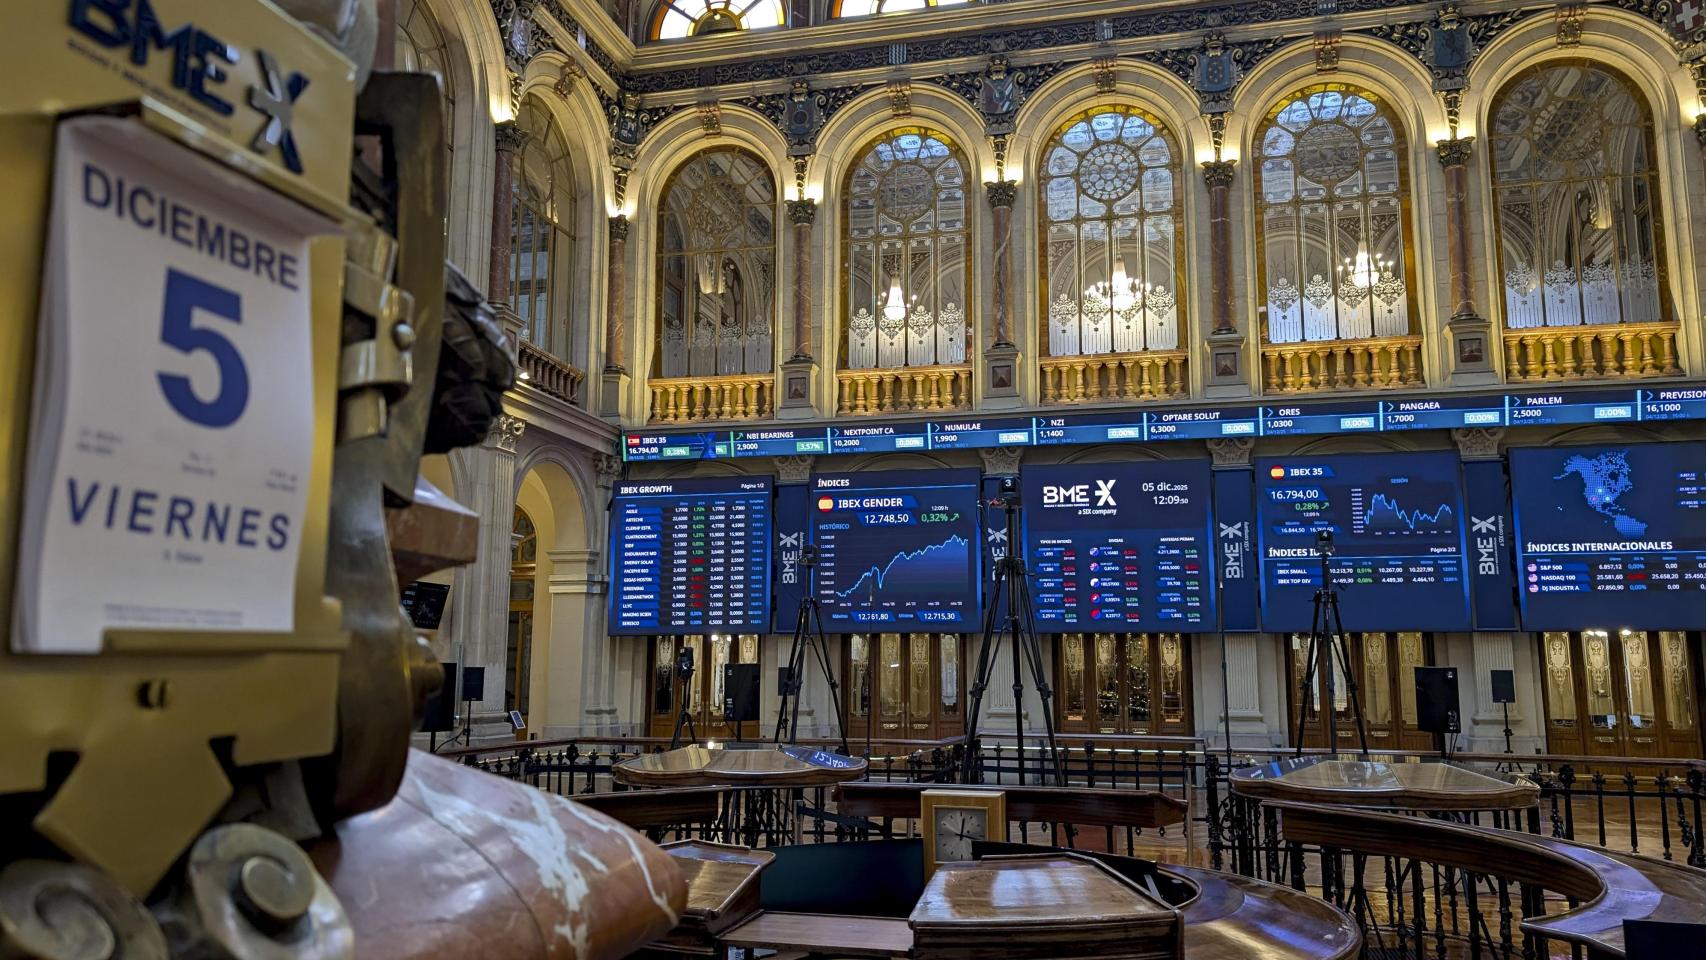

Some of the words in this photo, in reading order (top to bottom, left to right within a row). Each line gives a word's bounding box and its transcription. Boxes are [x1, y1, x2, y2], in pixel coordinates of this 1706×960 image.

[82, 163, 299, 291] DICIEMBRE
[156, 266, 251, 429] 5
[1527, 397, 1562, 405] PARLEM
[1400, 402, 1440, 411] PANGAEA
[1646, 404, 1681, 412] 16,1000
[1194, 412, 1220, 420] SOLUT
[1279, 408, 1300, 416] ORES
[1513, 410, 1541, 418] 2,5000
[1599, 408, 1626, 417] 0,00%
[1387, 415, 1414, 423] 1,7000
[1267, 420, 1292, 428] 1,0300
[844, 428, 882, 436] NEXTPOINT
[1040, 430, 1063, 438] 1,1400
[642, 436, 657, 444] IBEX
[658, 436, 667, 444] 35
[818, 479, 849, 487] ÍNDICES
[1142, 483, 1154, 491] 05
[621, 486, 638, 494] IBEX
[639, 485, 672, 493] GROWTH
[1043, 485, 1089, 503] BME
[1271, 490, 1318, 499] 16.794,00
[838, 499, 860, 508] IBEX
[863, 498, 903, 507] GENDER
[1296, 503, 1319, 511] 0,28%
[67, 477, 290, 550] VIERNES
[865, 514, 908, 523] 12.748,50
[921, 513, 948, 523] 0,32%
[1528, 543, 1570, 552] ÍNDICES
[1572, 542, 1672, 551] INTERNACIONALES
[1269, 547, 1308, 557] ÍNDICES
[1477, 538, 1495, 574] BME
[1225, 542, 1240, 578] BME
[783, 551, 794, 583] BME
